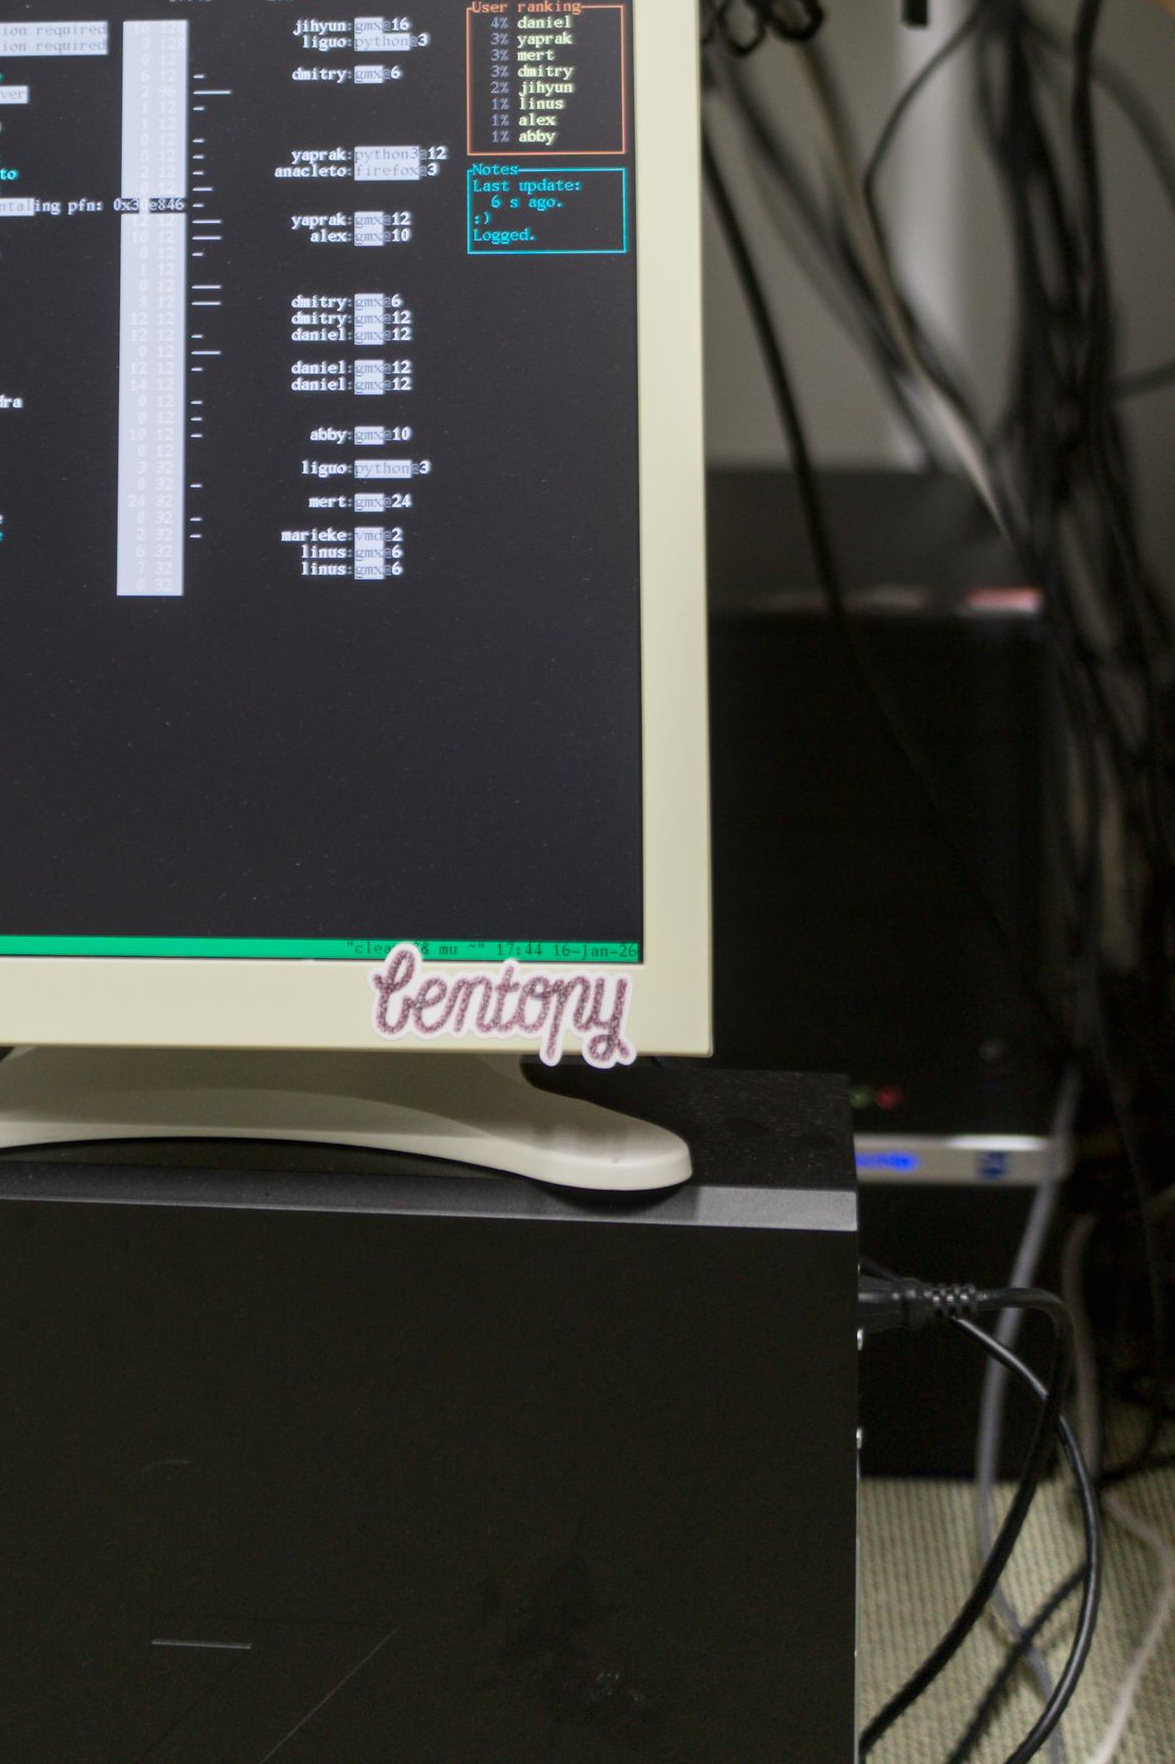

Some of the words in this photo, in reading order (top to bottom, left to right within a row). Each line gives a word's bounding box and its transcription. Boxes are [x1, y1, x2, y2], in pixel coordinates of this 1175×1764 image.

[470, 1, 507, 13] User
[515, 0, 579, 15] ranking
[36, 22, 107, 38] required
[488, 17, 507, 29] 4%
[515, 16, 570, 29] daniel
[36, 38, 107, 54] required
[488, 33, 507, 45] 3%
[515, 32, 570, 48] yaprak
[488, 49, 507, 61] 3%
[515, 48, 552, 61] mert
[489, 65, 508, 77] 3%
[516, 64, 571, 80] dmitry
[489, 81, 508, 94] 2%
[516, 80, 571, 96] jihyun
[489, 97, 508, 110] 1%
[516, 97, 562, 109] linus
[489, 113, 508, 126] 1%
[516, 113, 553, 126] alex
[489, 130, 508, 142] 1%
[516, 129, 554, 145] abby
[472, 162, 518, 175] Notes
[472, 178, 509, 191] Last
[517, 178, 582, 194] update:
[69, 198, 105, 214] pfn:
[526, 197, 564, 210] ago.
[472, 227, 537, 243] Logged.
[438, 944, 458, 956] mu
[497, 941, 543, 956] 17:44
